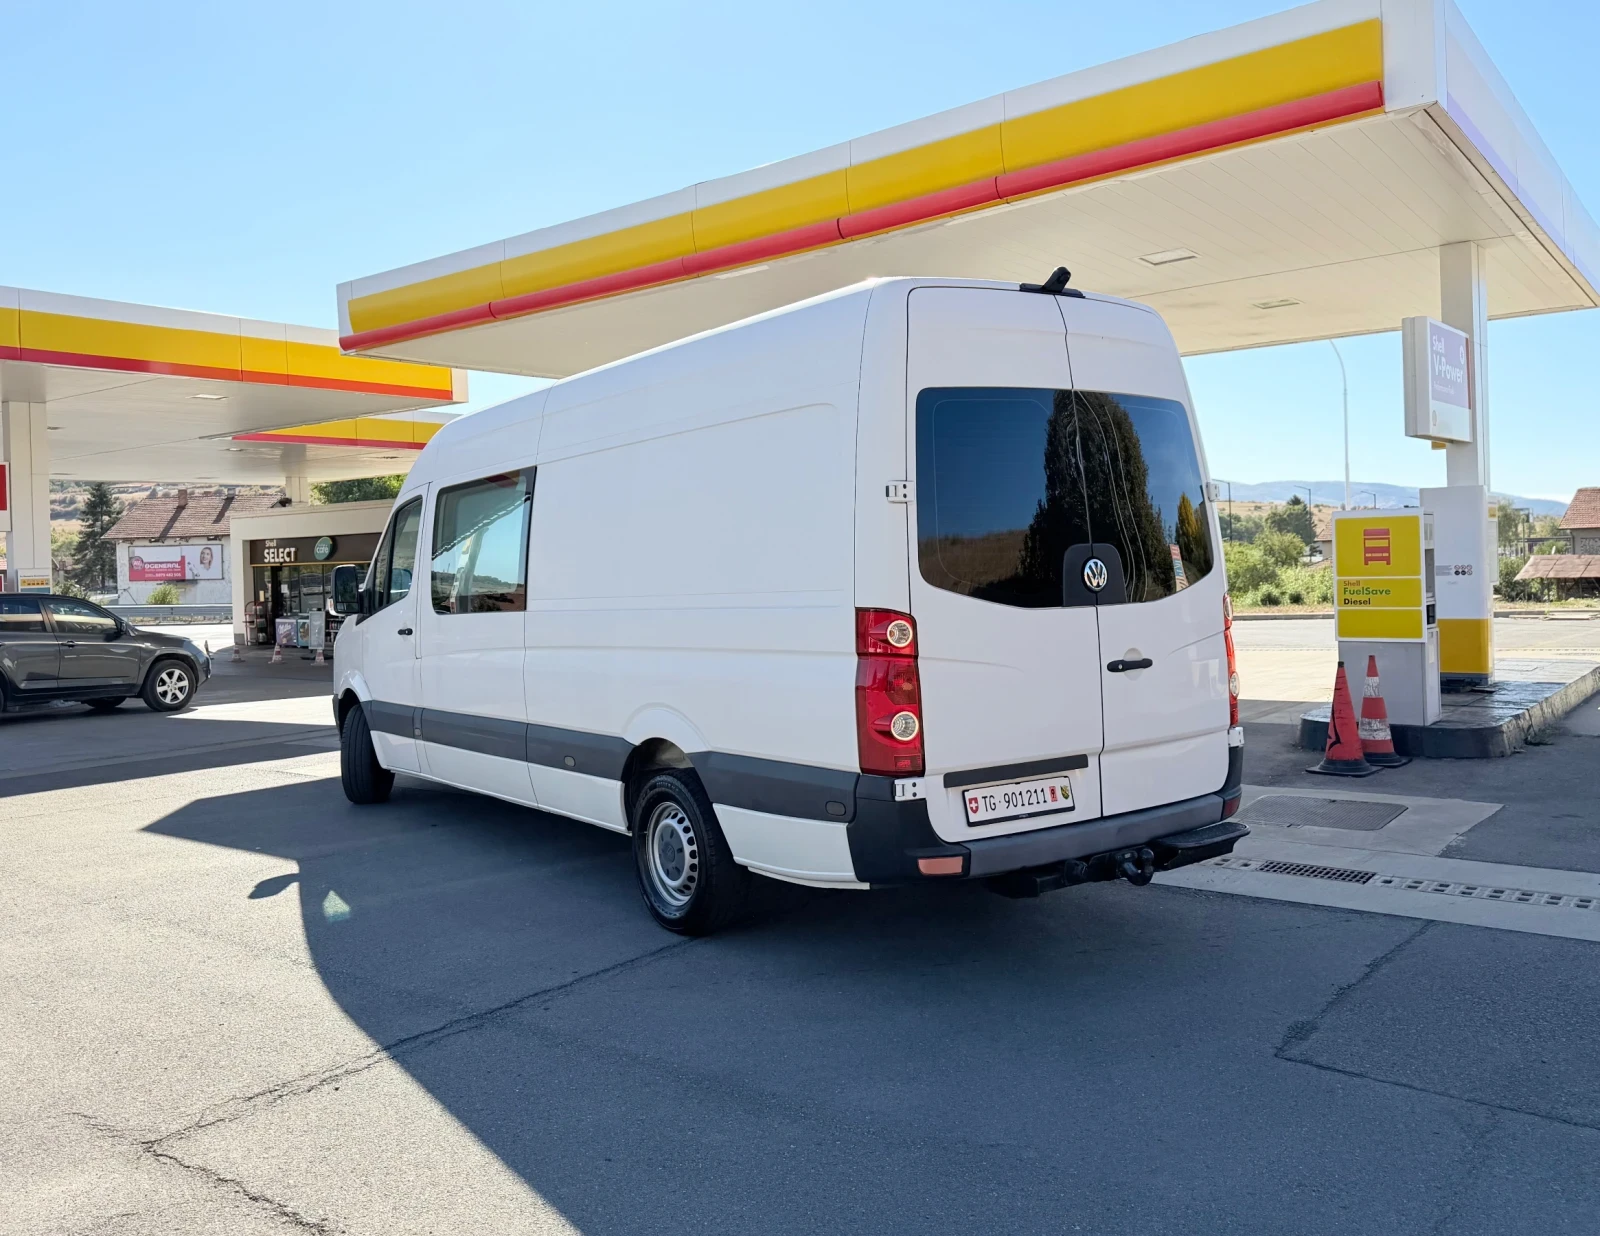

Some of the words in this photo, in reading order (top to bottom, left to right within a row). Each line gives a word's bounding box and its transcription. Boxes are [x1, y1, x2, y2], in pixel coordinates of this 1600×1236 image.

[1432, 334, 1445, 354] Shell
[1433, 353, 1463, 384] V-Power
[265, 539, 276, 547] Shell
[263, 547, 296, 563] SELECT
[1343, 587, 1391, 596] FuelSave
